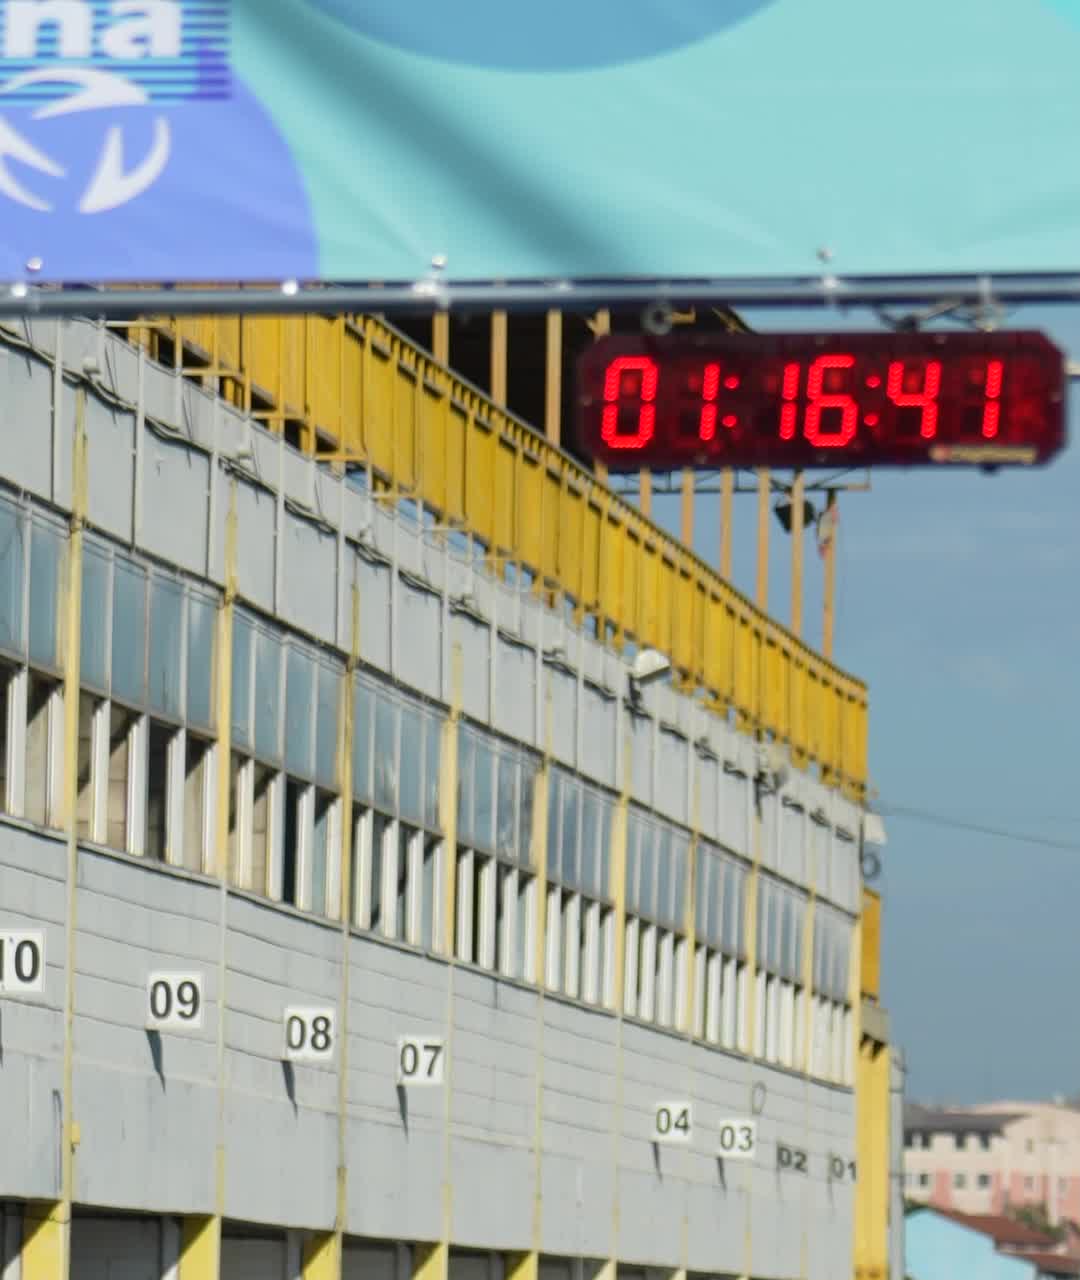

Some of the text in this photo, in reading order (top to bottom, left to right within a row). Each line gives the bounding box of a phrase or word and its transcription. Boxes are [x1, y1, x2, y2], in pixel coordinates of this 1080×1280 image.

[6, 0, 182, 58] na
[600, 354, 1003, 450] 01:16:41
[149, 980, 201, 1020] 09
[286, 1015, 333, 1052] 08
[400, 1043, 443, 1077] 07
[655, 1108, 690, 1135] 04
[720, 1126, 753, 1151] 03
